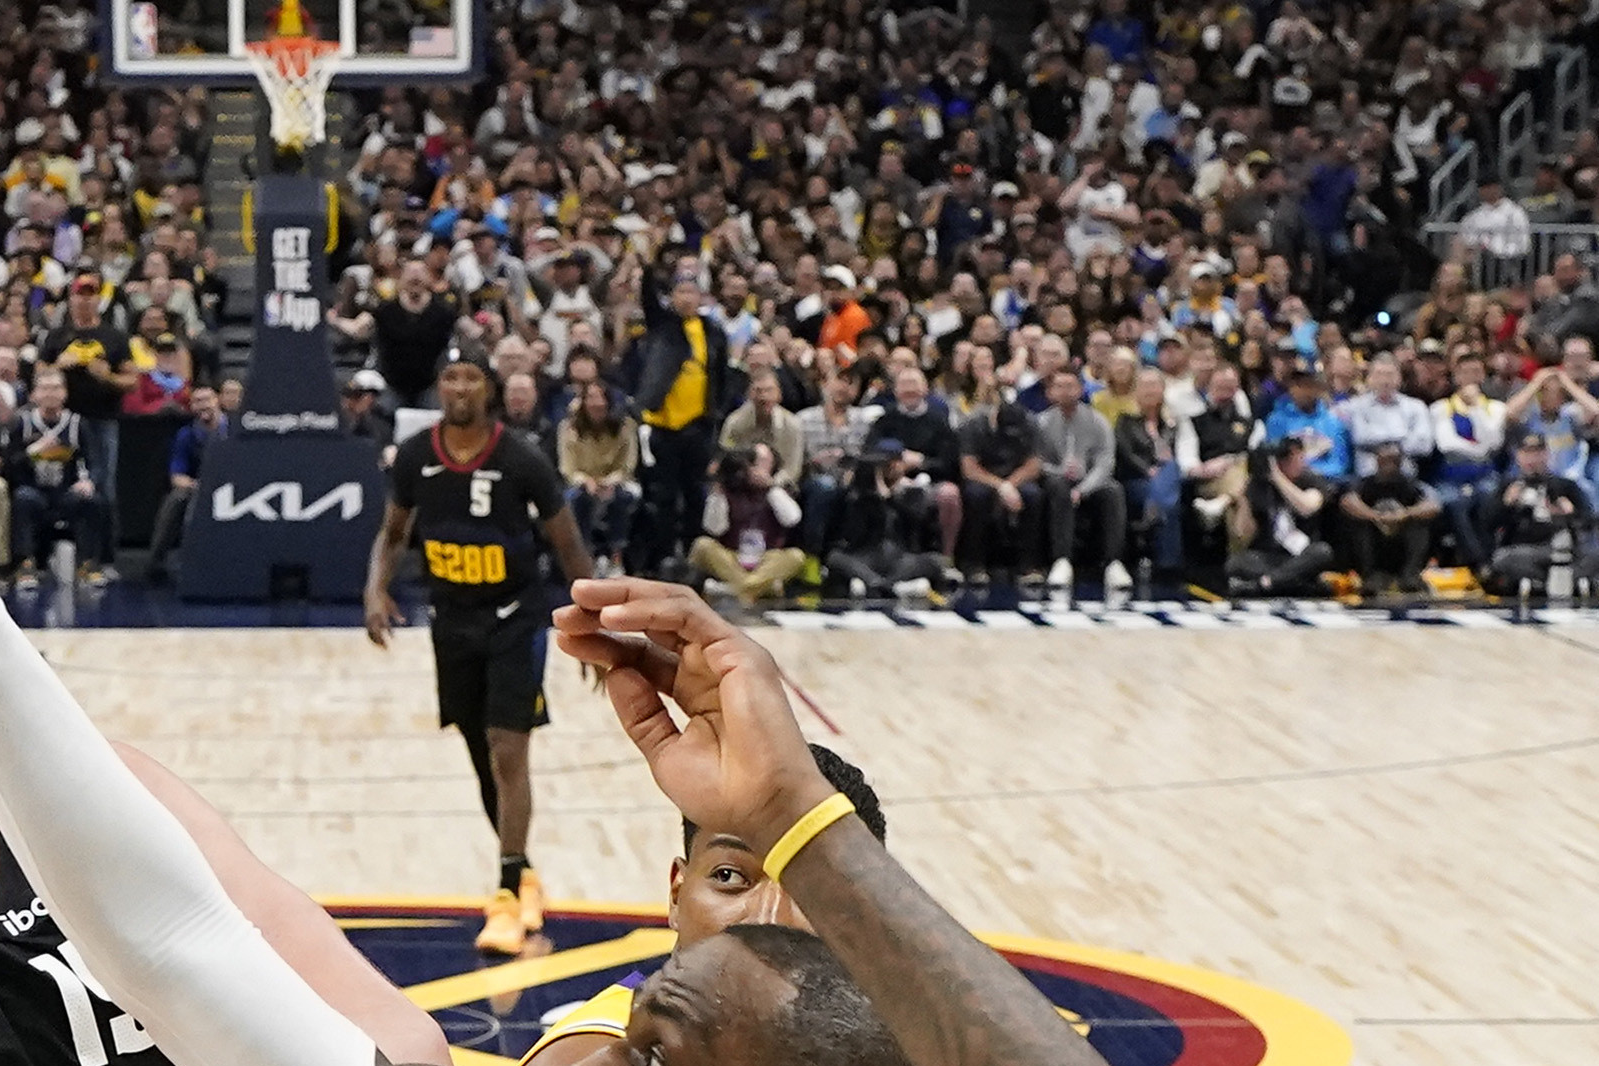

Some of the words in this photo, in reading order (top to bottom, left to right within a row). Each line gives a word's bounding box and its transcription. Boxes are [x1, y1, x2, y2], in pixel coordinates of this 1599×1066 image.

[213, 482, 363, 521] KIA
[469, 479, 492, 517] 5
[424, 540, 506, 583] 5280
